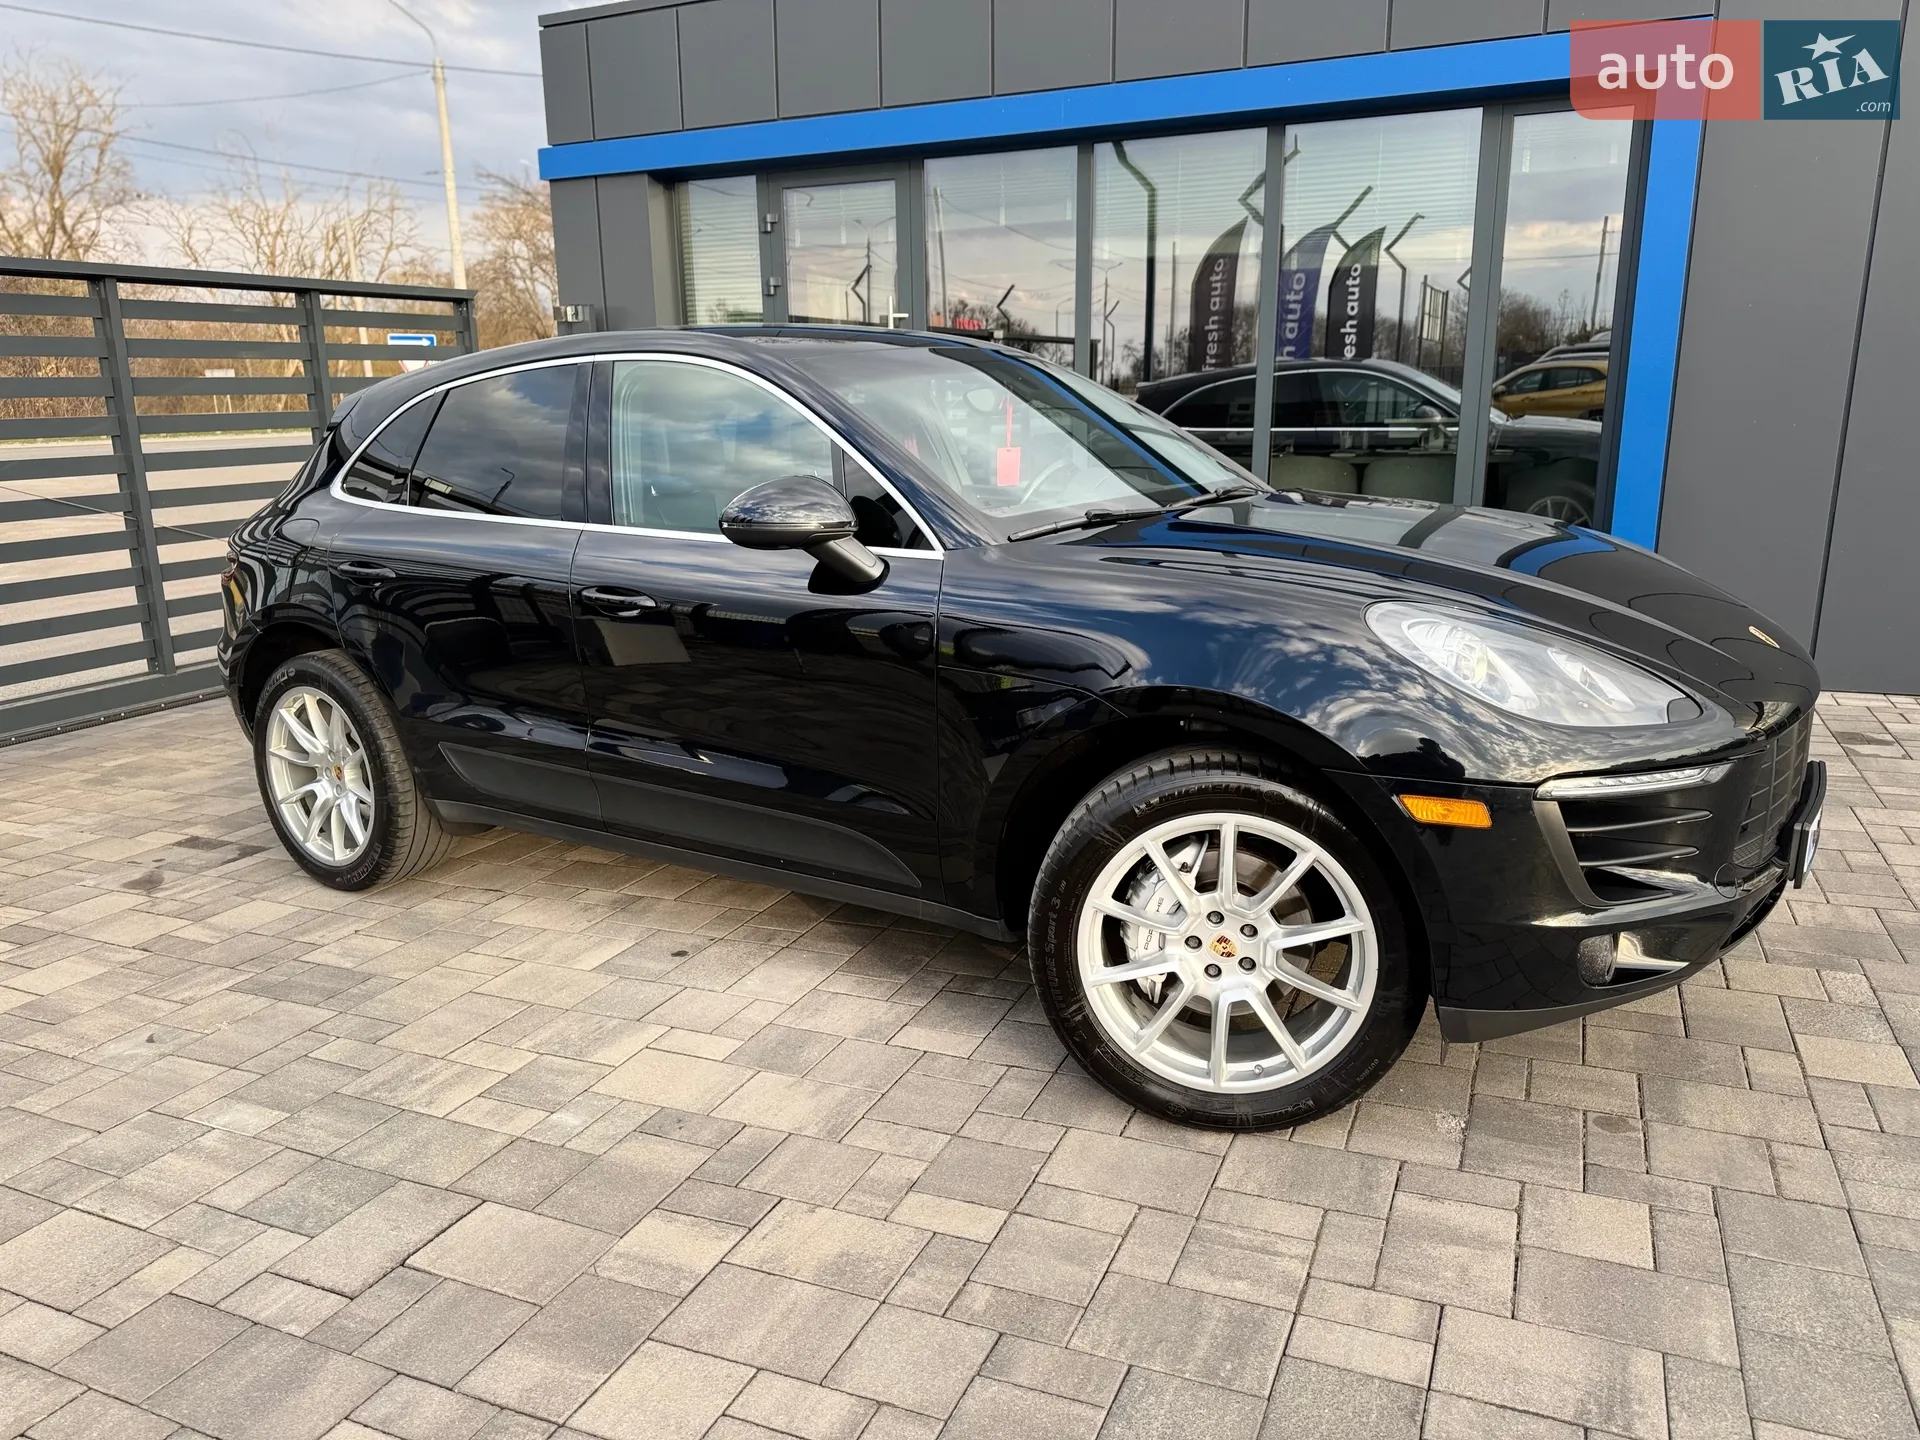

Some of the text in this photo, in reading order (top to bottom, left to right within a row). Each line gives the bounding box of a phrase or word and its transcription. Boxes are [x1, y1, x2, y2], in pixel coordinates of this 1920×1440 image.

[1209, 259, 1224, 311] auto
[1285, 272, 1306, 339] auto
[1346, 263, 1362, 316] auto
